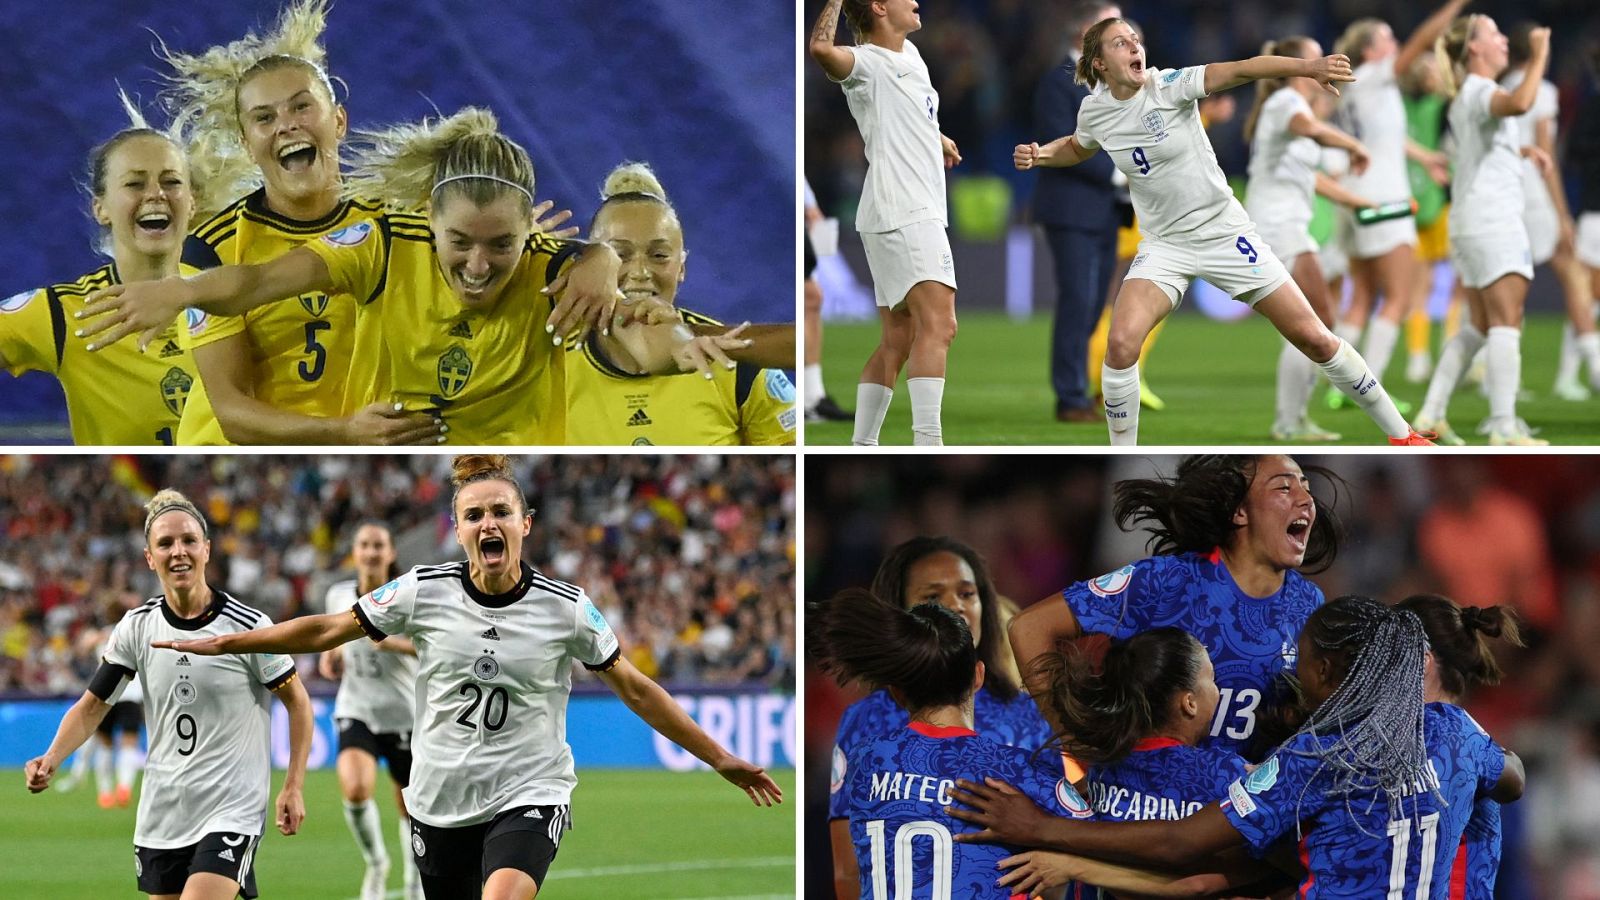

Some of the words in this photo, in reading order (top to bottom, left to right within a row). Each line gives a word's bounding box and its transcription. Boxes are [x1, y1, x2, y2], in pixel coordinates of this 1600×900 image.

[1131, 147, 1151, 175] 9
[1236, 236, 1258, 263] 9
[298, 320, 331, 382] 5
[456, 683, 509, 731] 20
[1209, 688, 1262, 740] 13
[176, 713, 197, 756] 9
[866, 819, 953, 900] 10
[1386, 811, 1440, 900] 11
